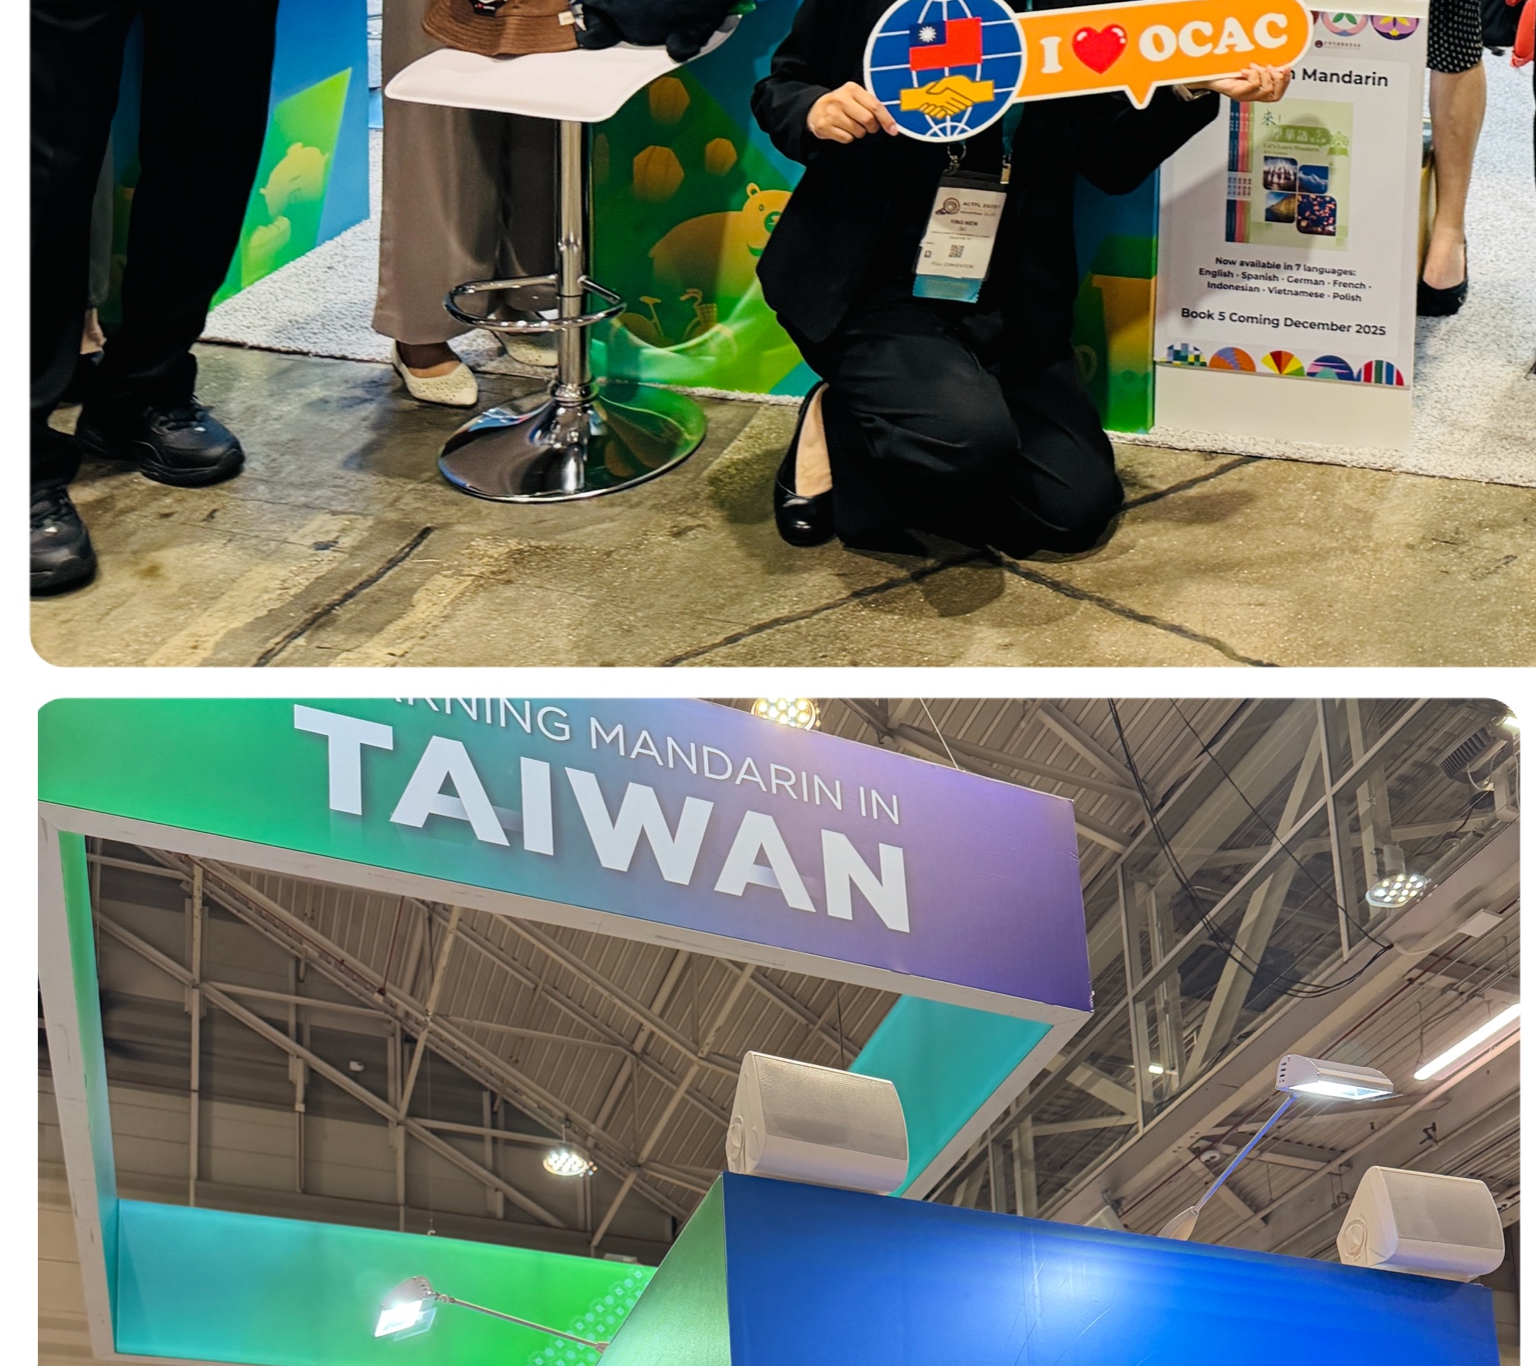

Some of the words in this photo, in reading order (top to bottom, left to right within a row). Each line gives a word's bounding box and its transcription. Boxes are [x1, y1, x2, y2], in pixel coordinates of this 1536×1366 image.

[1039, 35, 1064, 75] I
[1138, 12, 1289, 62] OCAC
[1301, 68, 1389, 87] Mandarin
[1198, 268, 1234, 279] English
[1241, 271, 1279, 283] Spanish
[1287, 276, 1325, 286] German
[1332, 280, 1366, 290] French
[1215, 257, 1237, 266] Now
[1239, 259, 1281, 270] available
[1284, 262, 1293, 270] in
[1295, 263, 1301, 271] 7
[1303, 264, 1356, 277] languages:
[1207, 281, 1260, 293] Indonesian
[1267, 286, 1325, 299] Vietnamese
[1332, 292, 1362, 302] Polish
[1181, 307, 1214, 321] Book
[1218, 311, 1226, 321] 5
[1229, 312, 1280, 328] Coming
[1284, 317, 1352, 333] December
[1355, 323, 1386, 336] 2025
[590, 717, 844, 812] MANDARIN
[859, 788, 901, 825] IN
[293, 703, 912, 934] TAIWAN
